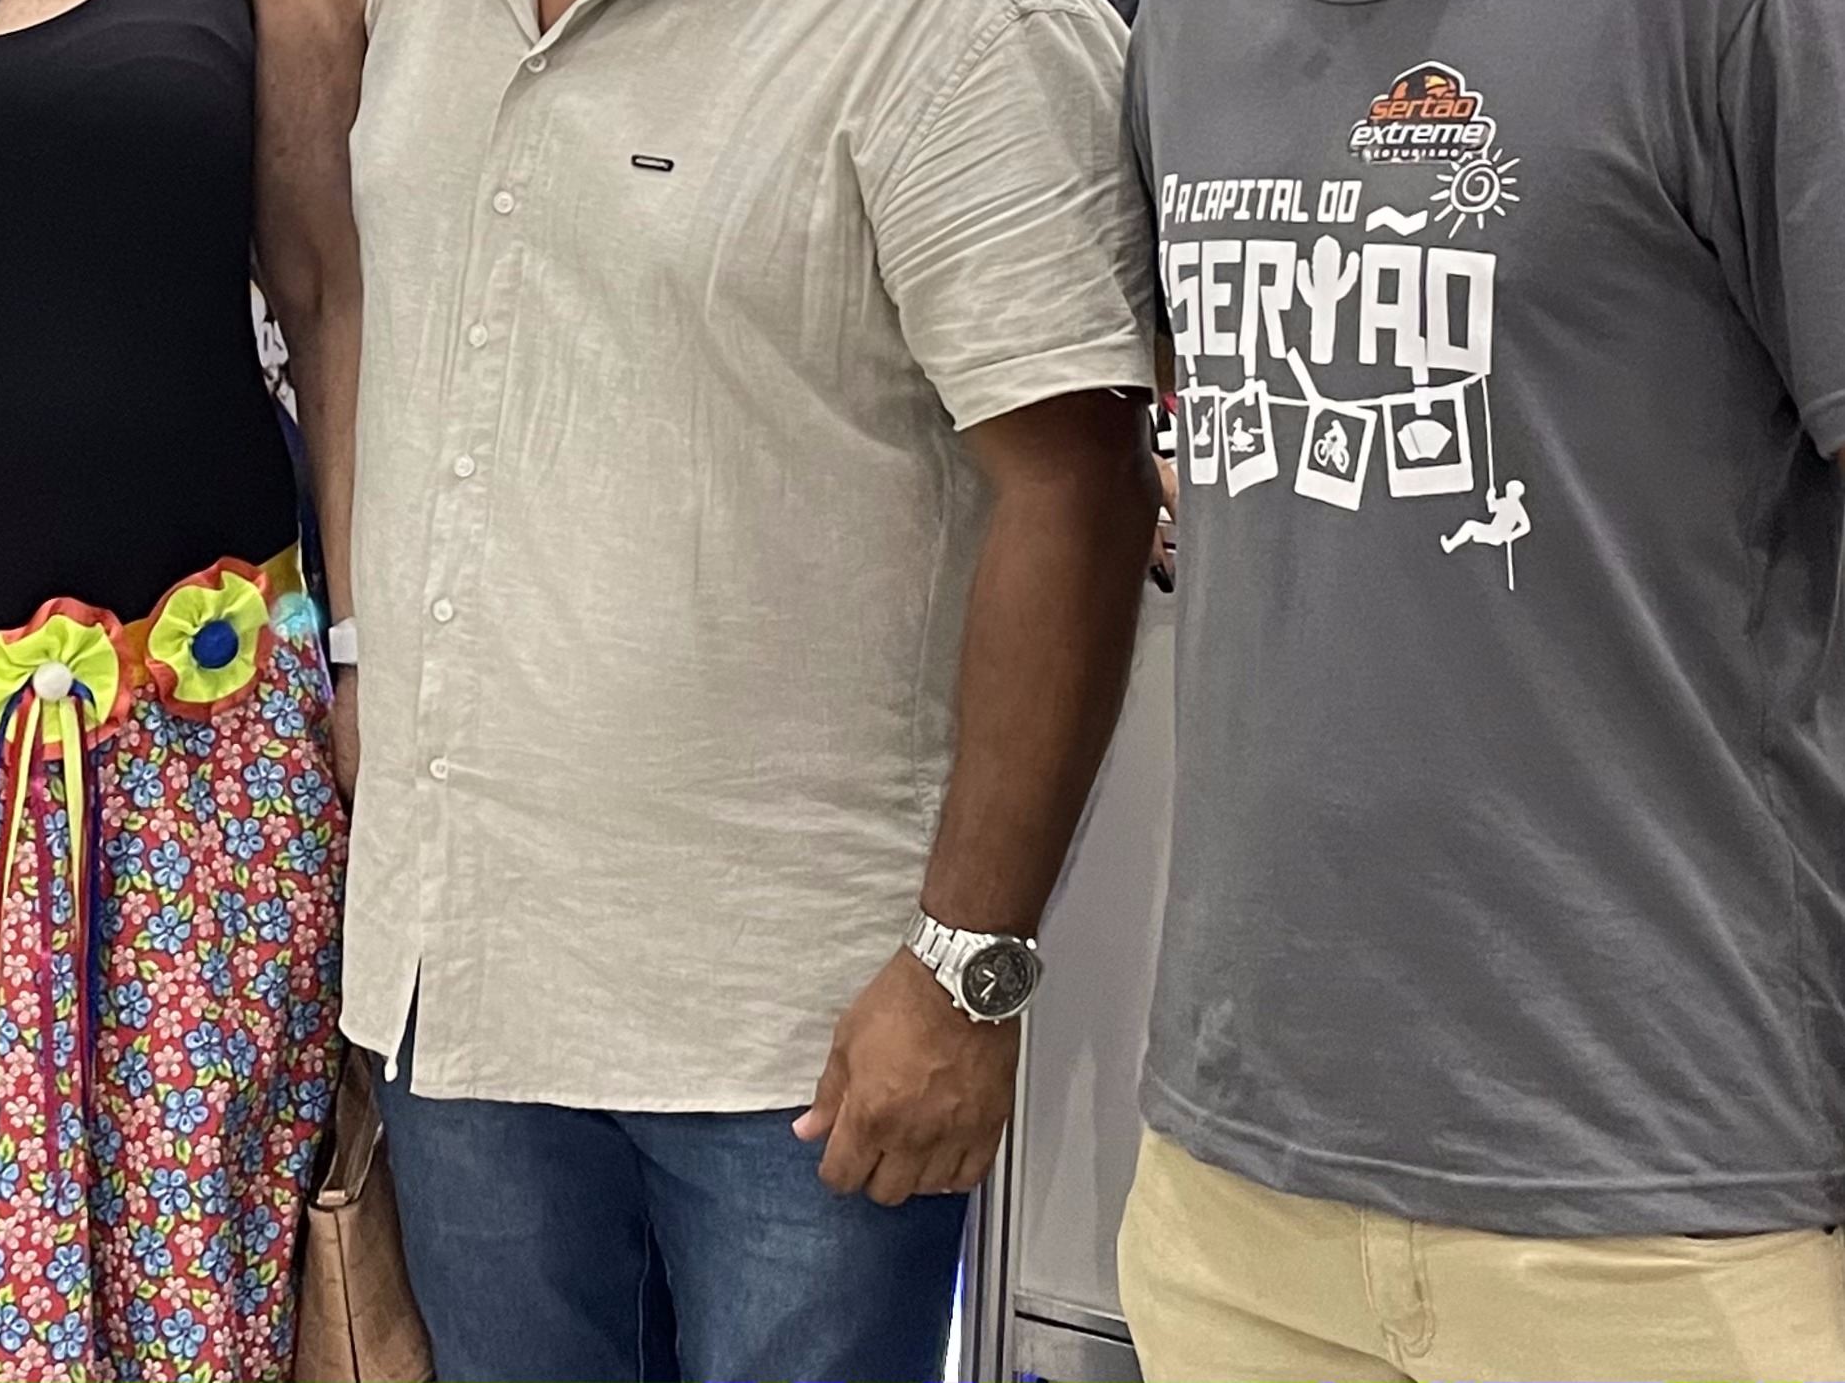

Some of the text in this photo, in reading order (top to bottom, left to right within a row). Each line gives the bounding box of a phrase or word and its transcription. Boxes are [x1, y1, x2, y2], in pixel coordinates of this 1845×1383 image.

[1350, 120, 1485, 146] extreme
[1175, 178, 1363, 224] A CAPITAL DO
